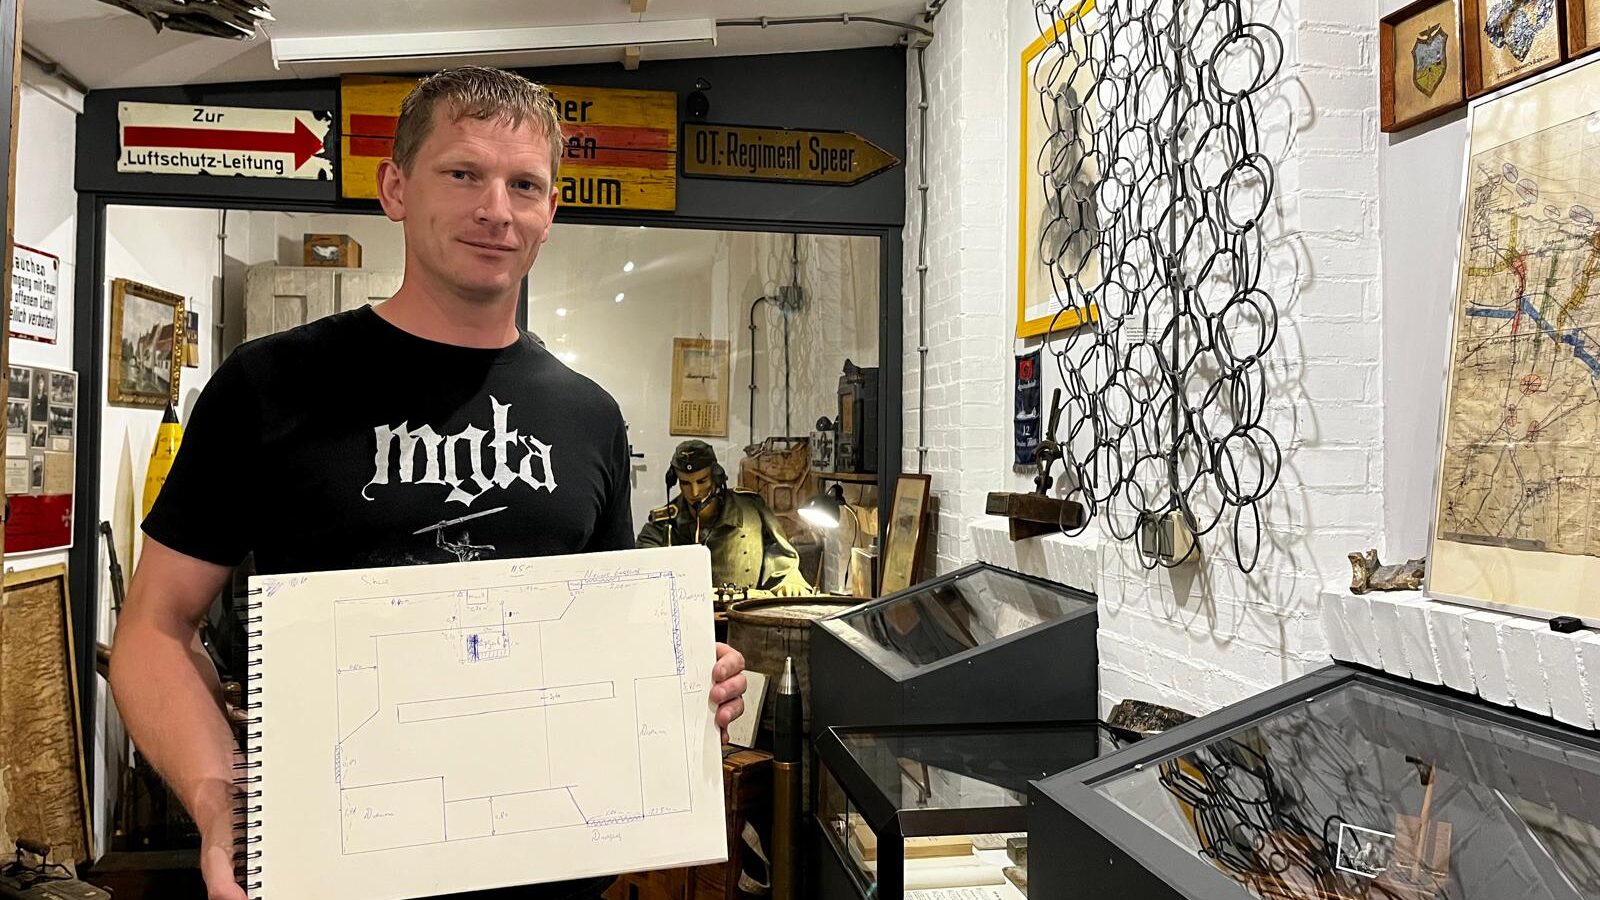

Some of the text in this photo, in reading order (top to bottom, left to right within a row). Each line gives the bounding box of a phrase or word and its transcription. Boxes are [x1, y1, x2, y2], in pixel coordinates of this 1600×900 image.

[192, 108, 225, 123] Zur
[561, 136, 596, 159] en
[808, 136, 857, 175] Speer
[127, 151, 284, 175] Luftschutz-Leitung
[556, 176, 622, 205] aum
